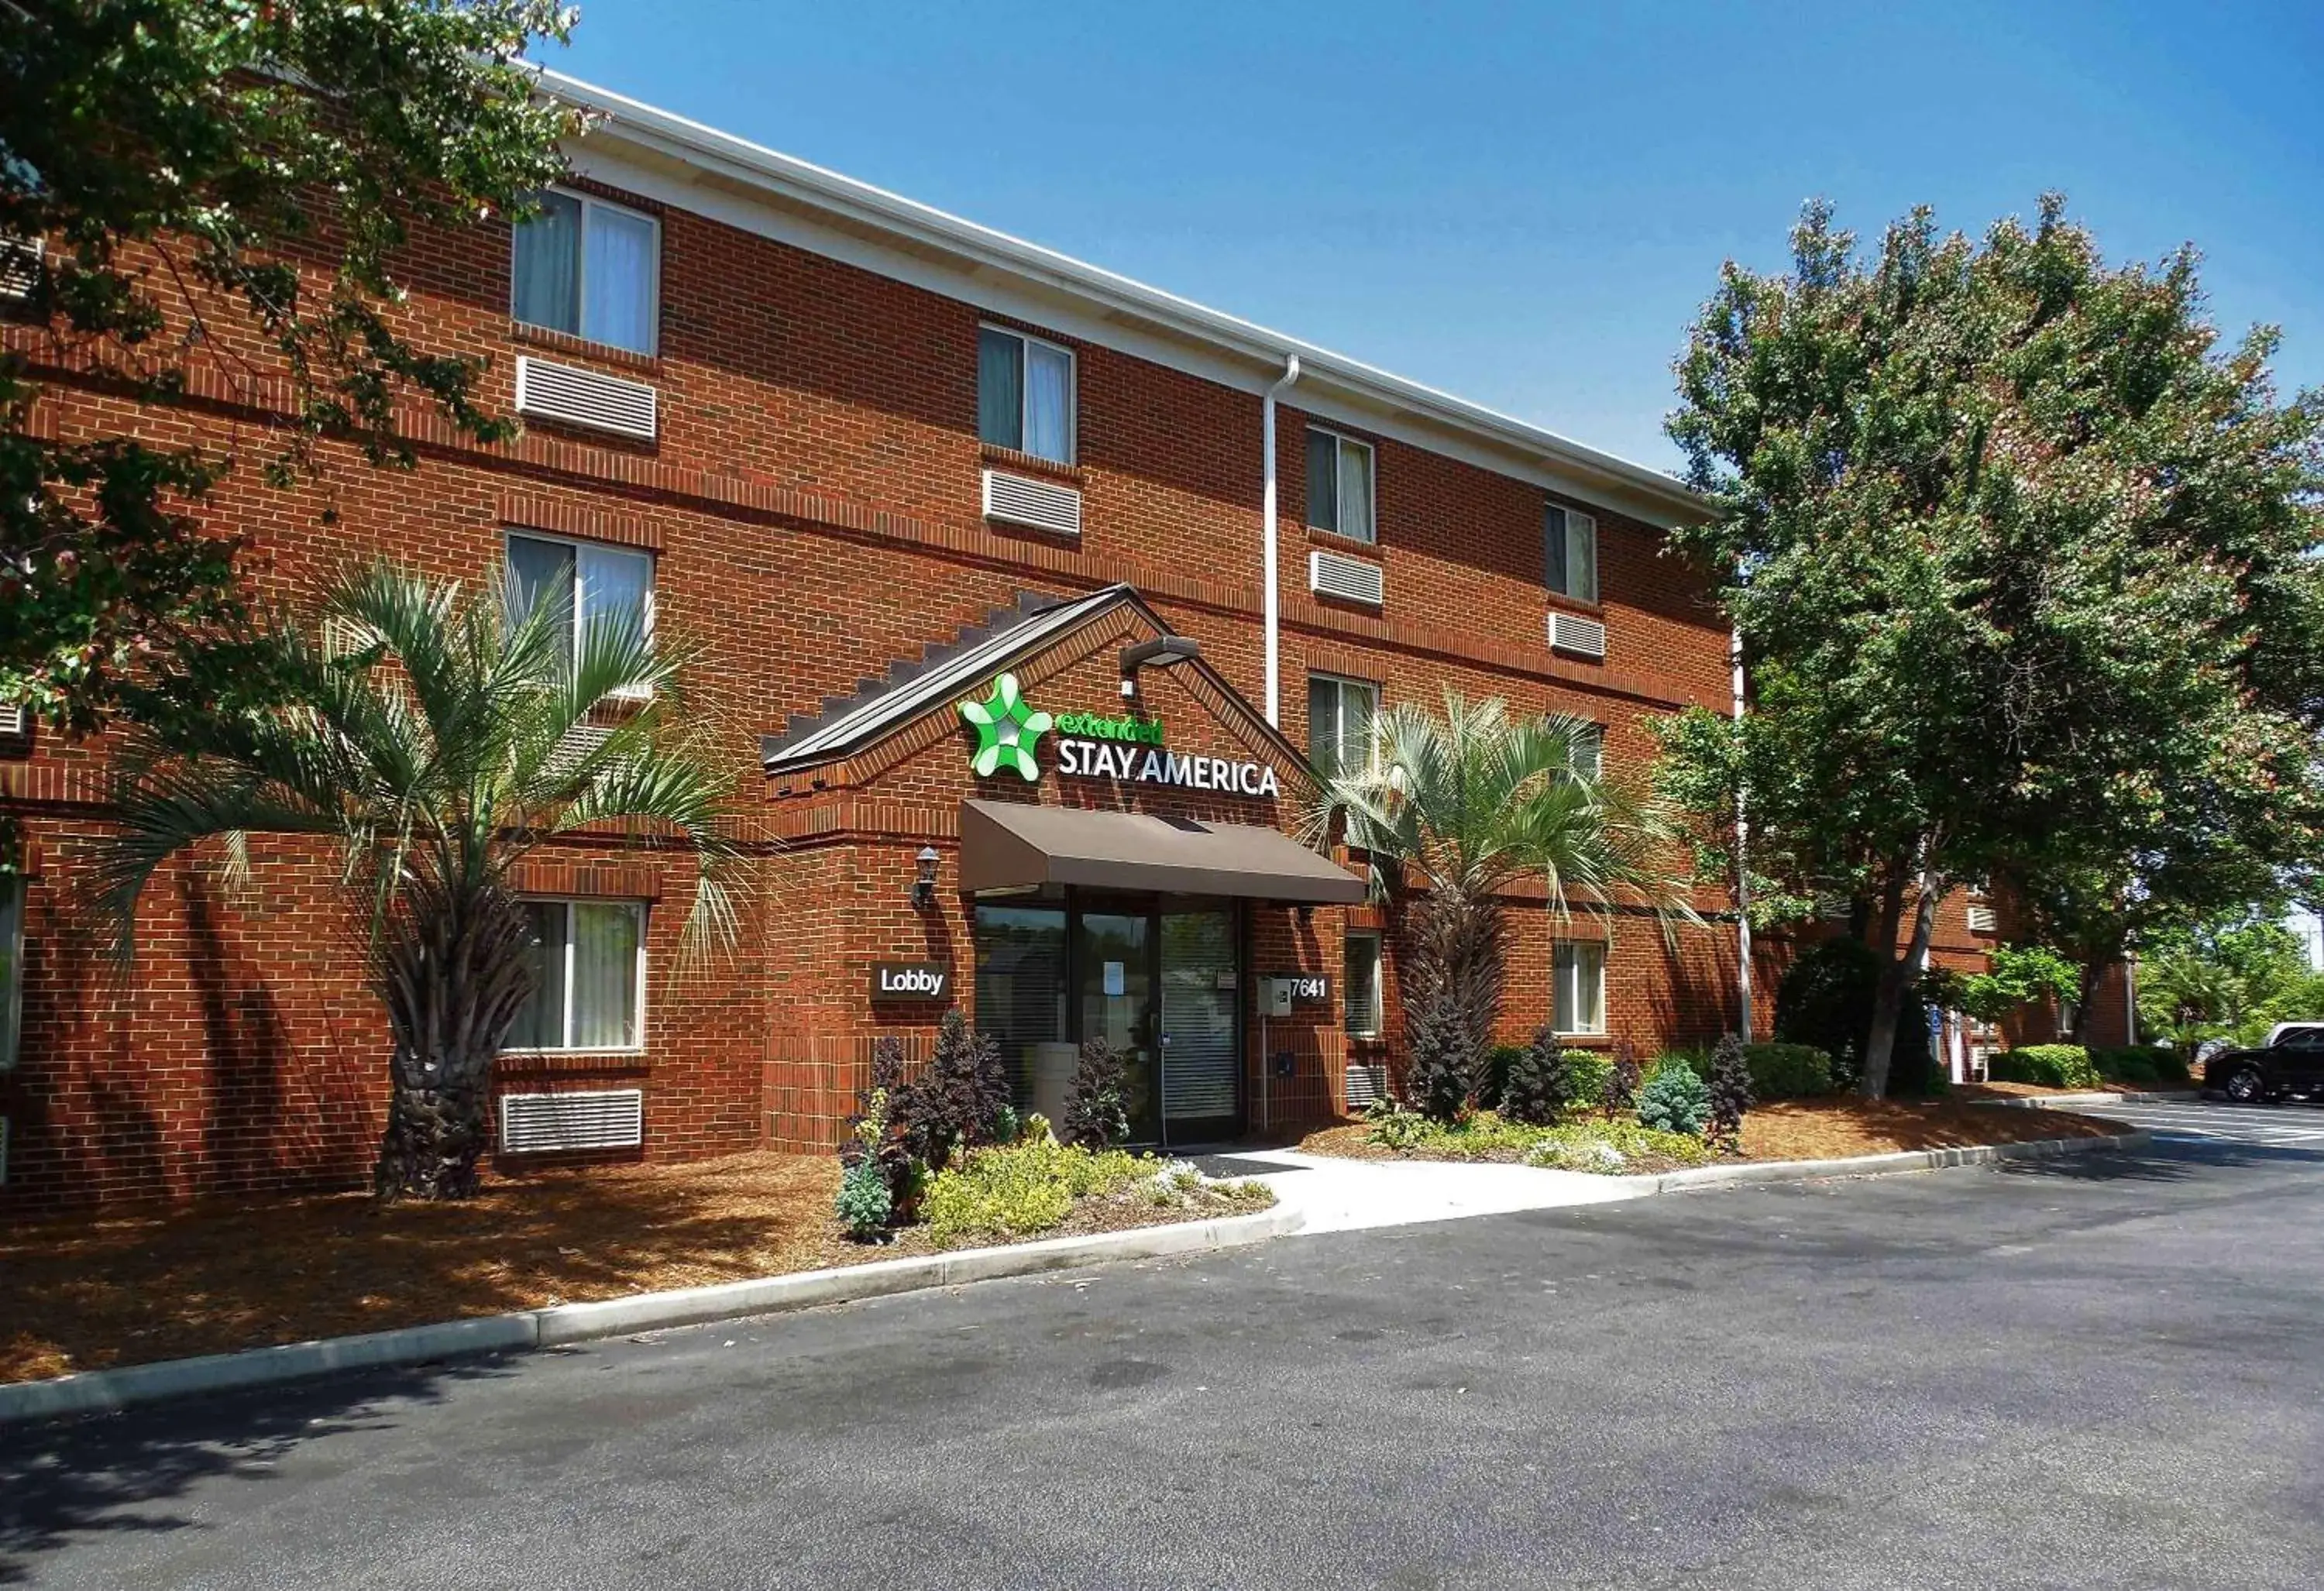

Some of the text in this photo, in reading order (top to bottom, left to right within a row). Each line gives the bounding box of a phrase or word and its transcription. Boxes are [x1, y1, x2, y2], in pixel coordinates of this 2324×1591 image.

[1057, 713, 1163, 744] extended
[1058, 739, 1279, 797] STAY AMERICA
[881, 969, 944, 995] Lobby
[1291, 978, 1325, 997] 7641
